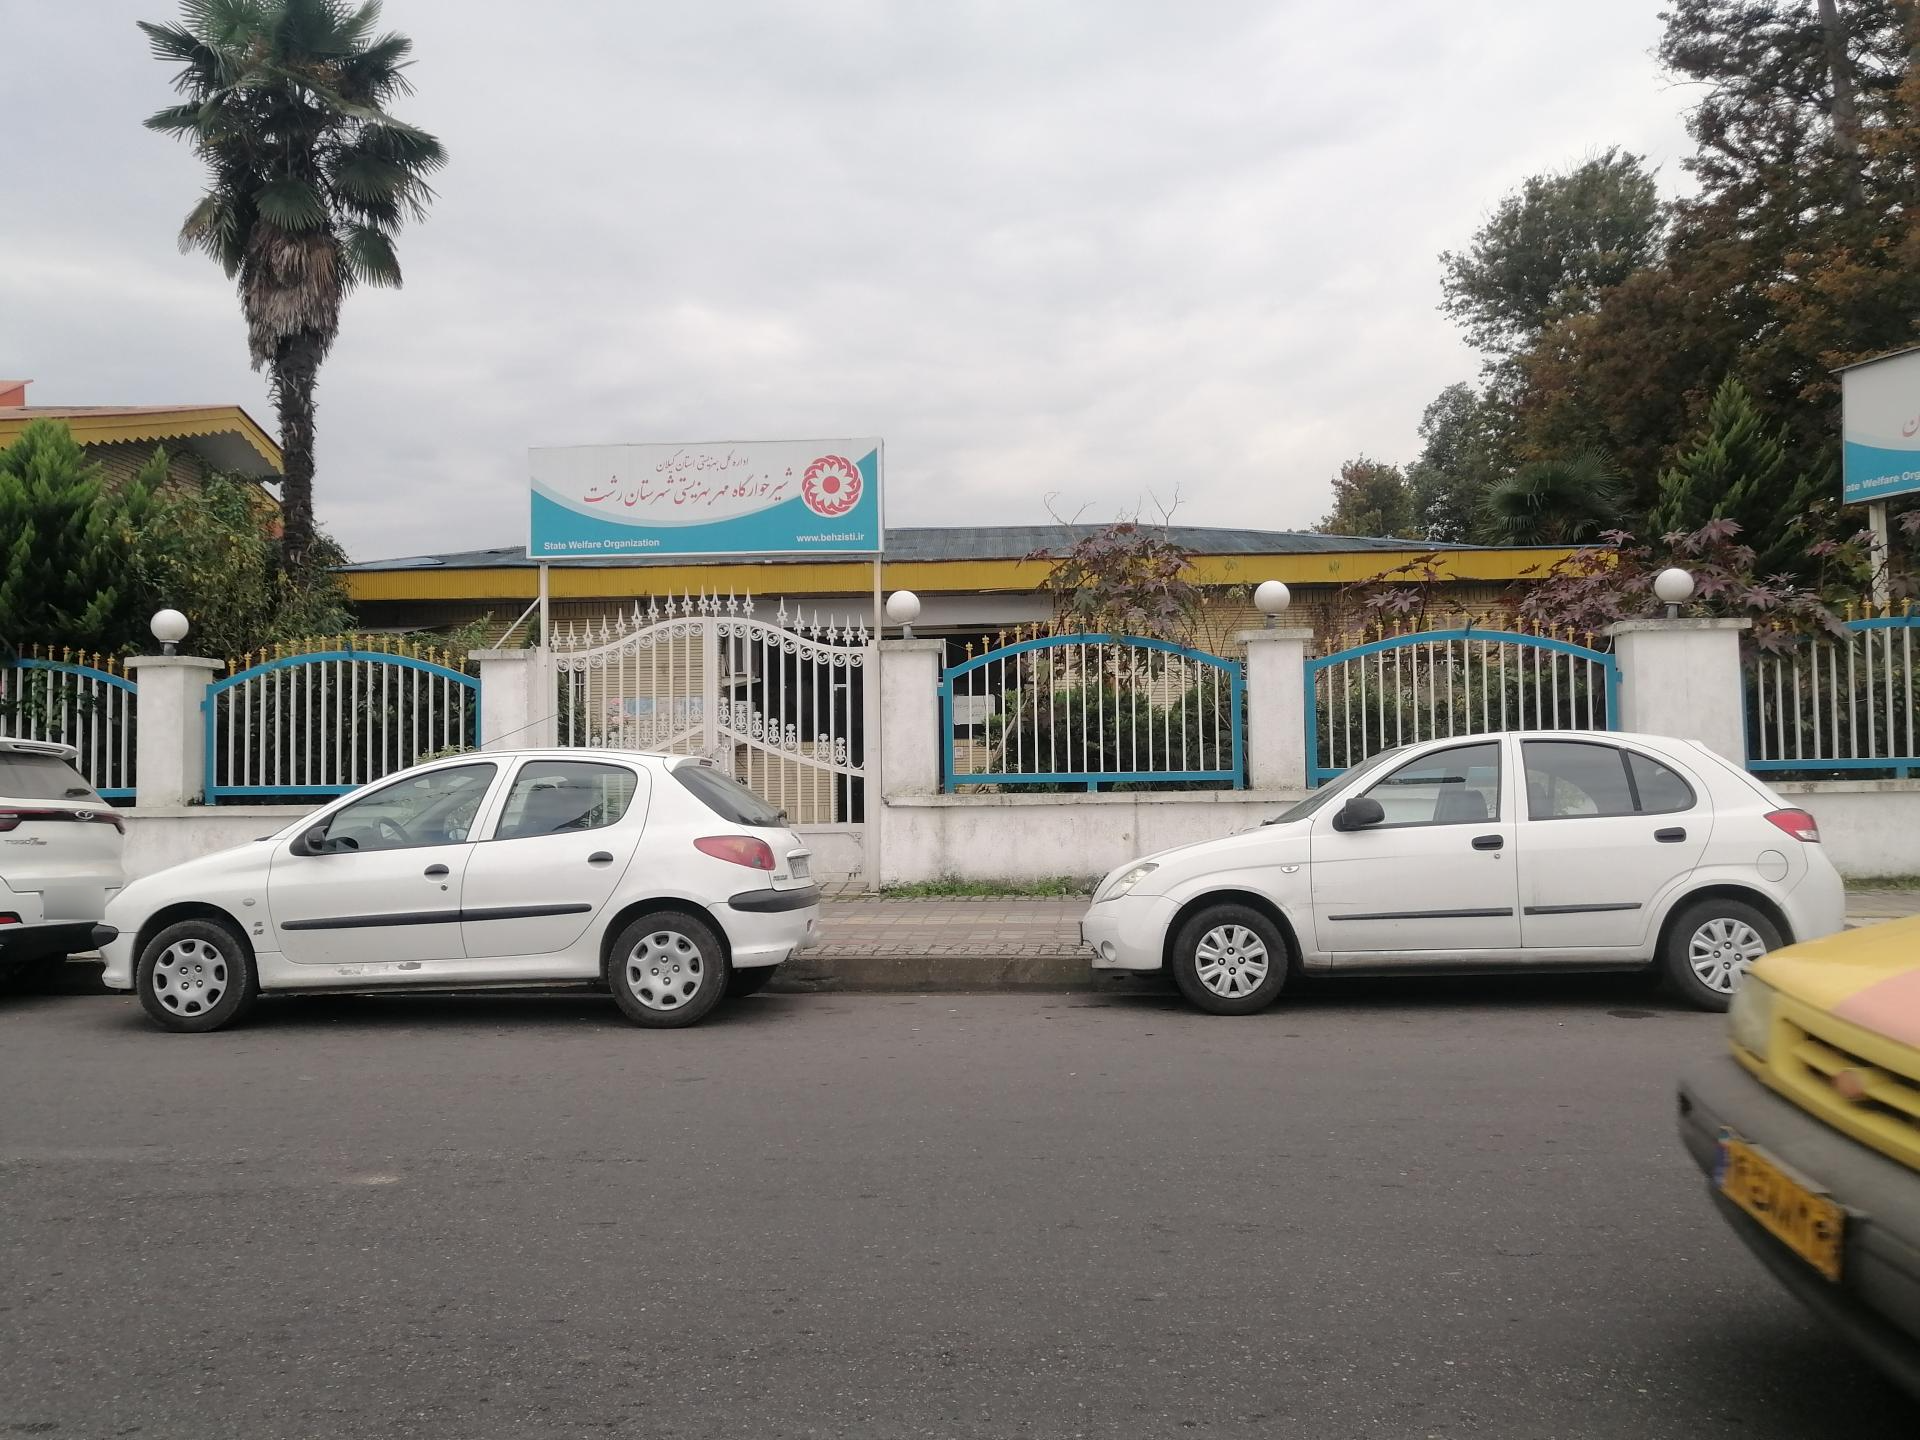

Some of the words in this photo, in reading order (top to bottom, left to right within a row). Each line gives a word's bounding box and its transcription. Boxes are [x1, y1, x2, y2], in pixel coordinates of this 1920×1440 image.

[655, 449, 685, 474] گیلان
[675, 455, 696, 472] استان
[696, 455, 719, 472] بهزیستی
[719, 449, 735, 470] کل
[732, 457, 749, 467] اداره
[583, 475, 622, 503] رشت
[624, 475, 674, 507] شهرستان
[1845, 483, 1860, 493] ate
[1862, 475, 1899, 488] Welfare
[711, 485, 729, 502] مهر
[543, 541, 567, 551] State
[568, 540, 602, 550] Welfare
[603, 538, 660, 550] Organization
[796, 531, 865, 543] www.behzisti.ir
